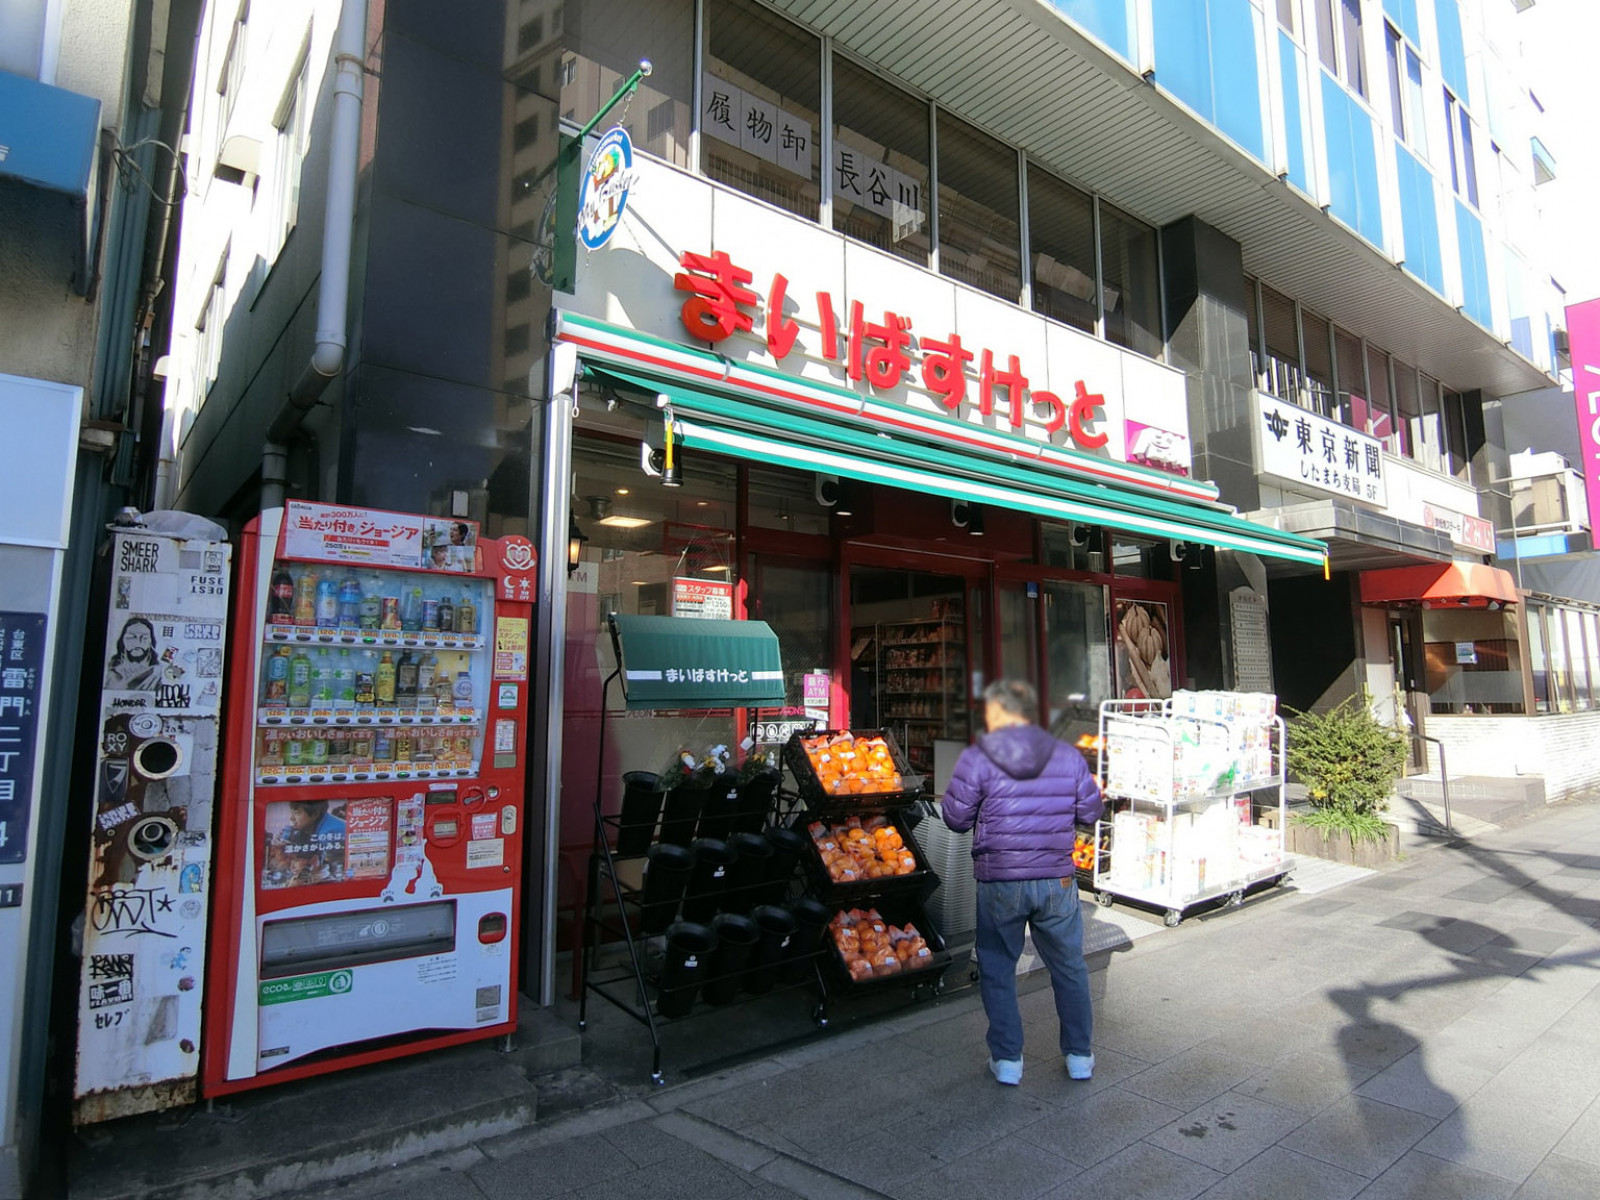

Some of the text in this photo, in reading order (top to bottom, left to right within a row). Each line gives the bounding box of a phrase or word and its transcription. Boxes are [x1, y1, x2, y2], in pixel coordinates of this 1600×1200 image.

[706, 91, 919, 210] 履物卸 長谷川
[675, 250, 1109, 449] まいばすけっと
[1295, 417, 1380, 479] 東京新聞
[1301, 460, 1377, 500] したまち支局 5F
[299, 516, 420, 540] 当たり付き ジョージア
[121, 540, 159, 558] SMEER
[120, 556, 158, 573] SHARK
[191, 576, 224, 585] FUSE
[11, 629, 25, 660] 台東区
[666, 668, 749, 683] まいばすけっと
[807, 688, 826, 696] ATM
[349, 816, 389, 828] ジョージア
[95, 1008, 130, 1029] セレブ
